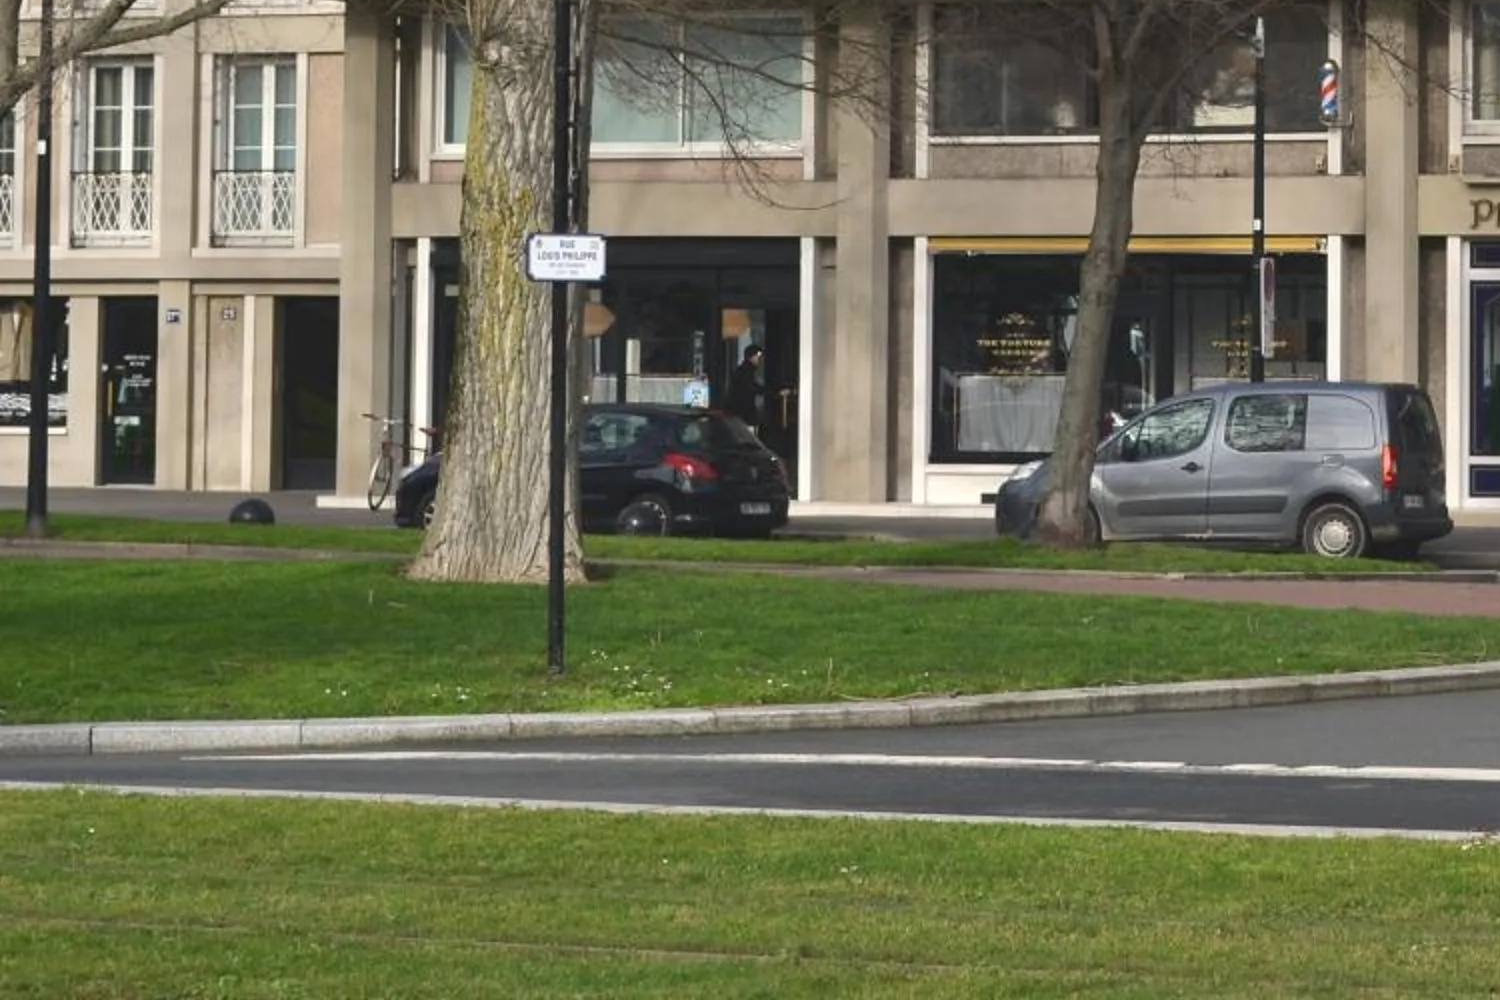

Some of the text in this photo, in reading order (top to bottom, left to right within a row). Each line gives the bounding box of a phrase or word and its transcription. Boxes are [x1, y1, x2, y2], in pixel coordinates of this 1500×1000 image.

[560, 239, 576, 249] RUE
[537, 251, 597, 261] LOUIS PHILIPPE
